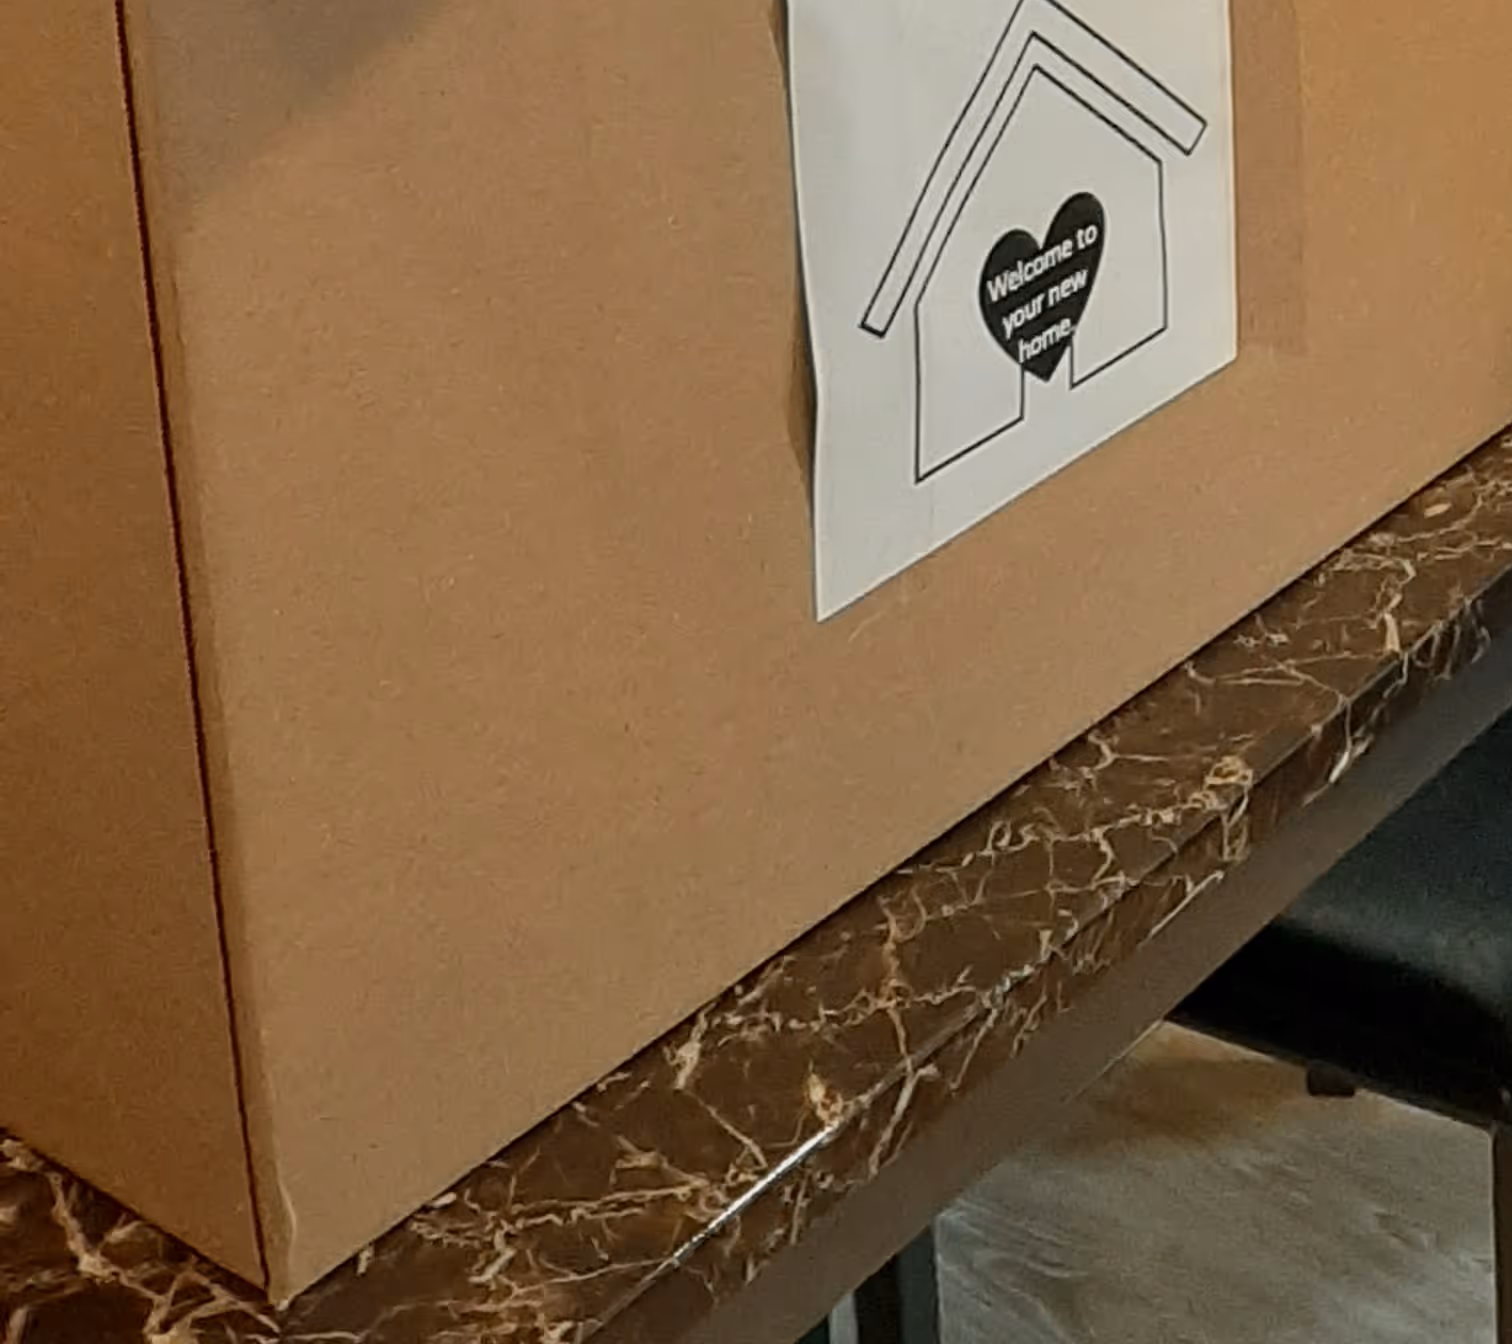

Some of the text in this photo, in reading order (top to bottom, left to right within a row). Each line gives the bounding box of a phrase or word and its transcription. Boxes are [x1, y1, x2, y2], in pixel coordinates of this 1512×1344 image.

[986, 224, 1098, 303] Welcome to
[1002, 269, 1088, 341] your new
